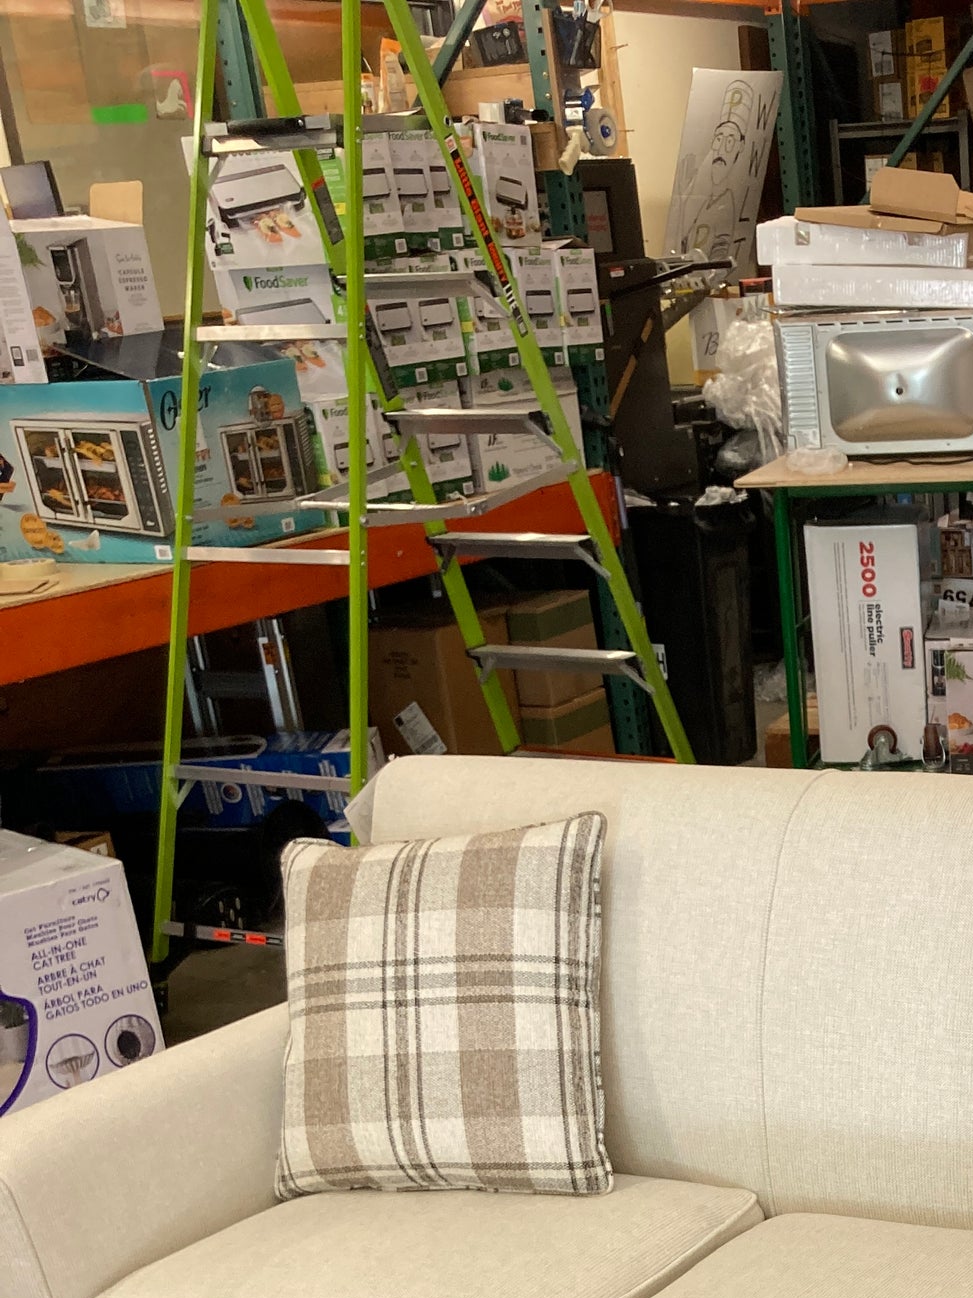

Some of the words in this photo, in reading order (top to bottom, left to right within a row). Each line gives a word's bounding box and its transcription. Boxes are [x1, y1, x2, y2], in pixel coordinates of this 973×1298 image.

[254, 275, 309, 289] FoodSaver
[858, 541, 877, 598] 2500
[866, 604, 874, 623] line
[874, 603, 883, 644] electric
[867, 626, 876, 657] puller
[31, 937, 88, 961] ALL-IN-ONE
[33, 957, 53, 971] CAT
[55, 951, 77, 965] TREE
[37, 969, 67, 986] ARBRE
[80, 956, 106, 972] CHAT
[38, 970, 97, 996] TOUT-EN-UN
[45, 1004, 80, 1021] GATOS
[81, 994, 110, 1009] TODO
[111, 988, 125, 999] EN
[126, 980, 149, 994] UNO
[77, 985, 104, 999] PARA
